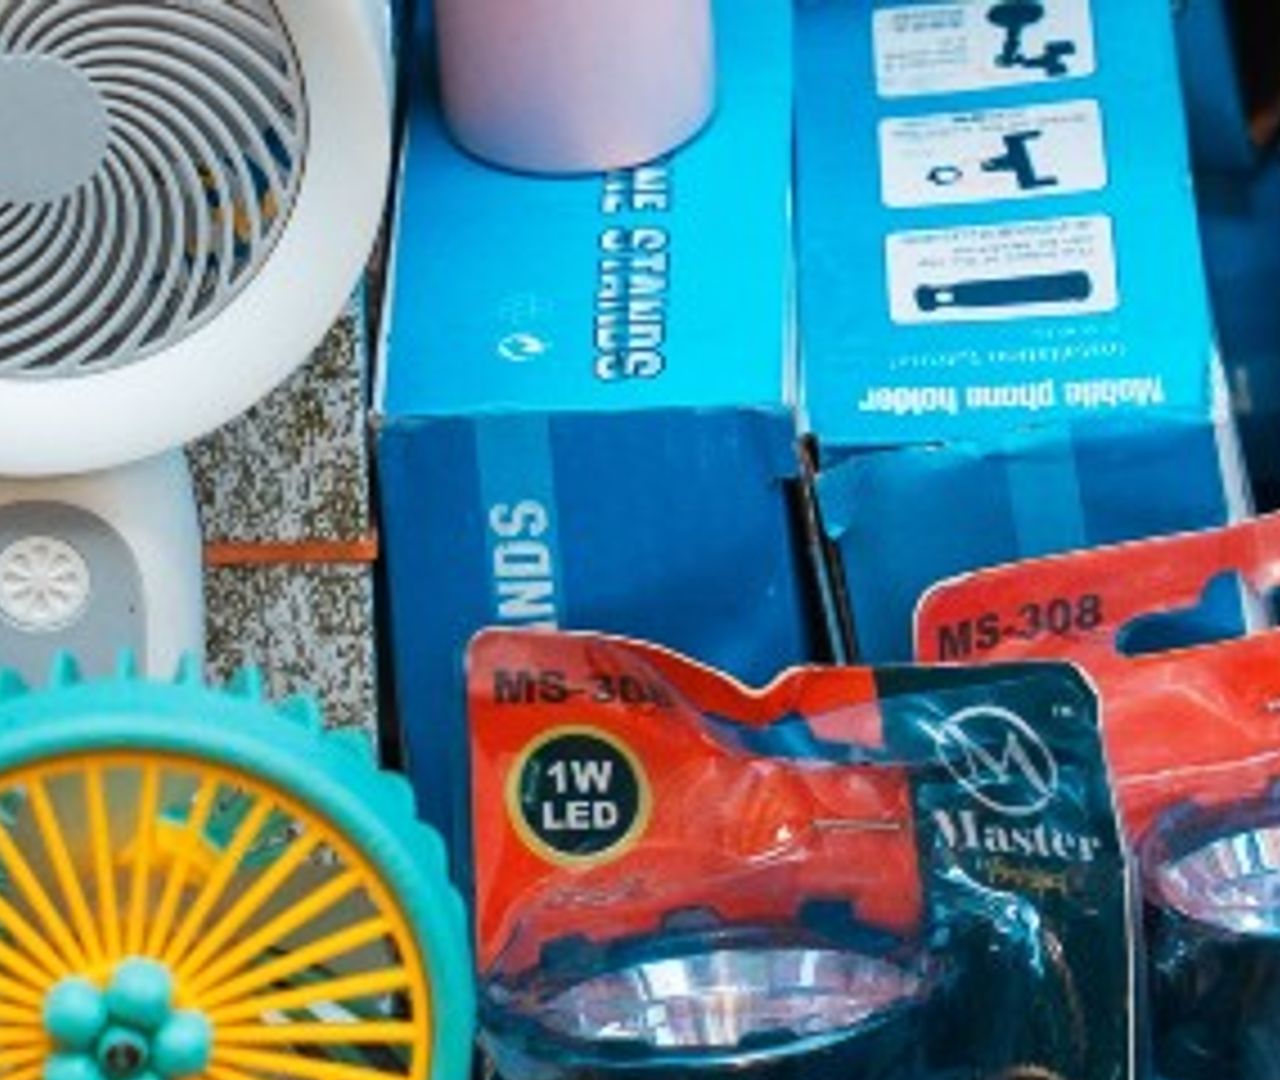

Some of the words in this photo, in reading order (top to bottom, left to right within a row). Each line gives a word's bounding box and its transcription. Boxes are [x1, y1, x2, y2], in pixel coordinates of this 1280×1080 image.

[859, 386, 959, 414] holder
[967, 378, 1059, 411] phone
[1065, 375, 1166, 409] Mobile
[488, 498, 557, 631] NDS
[937, 594, 1103, 661] MS-308
[547, 761, 613, 794] 1W
[542, 800, 618, 831] LED
[930, 810, 1102, 862] Master
